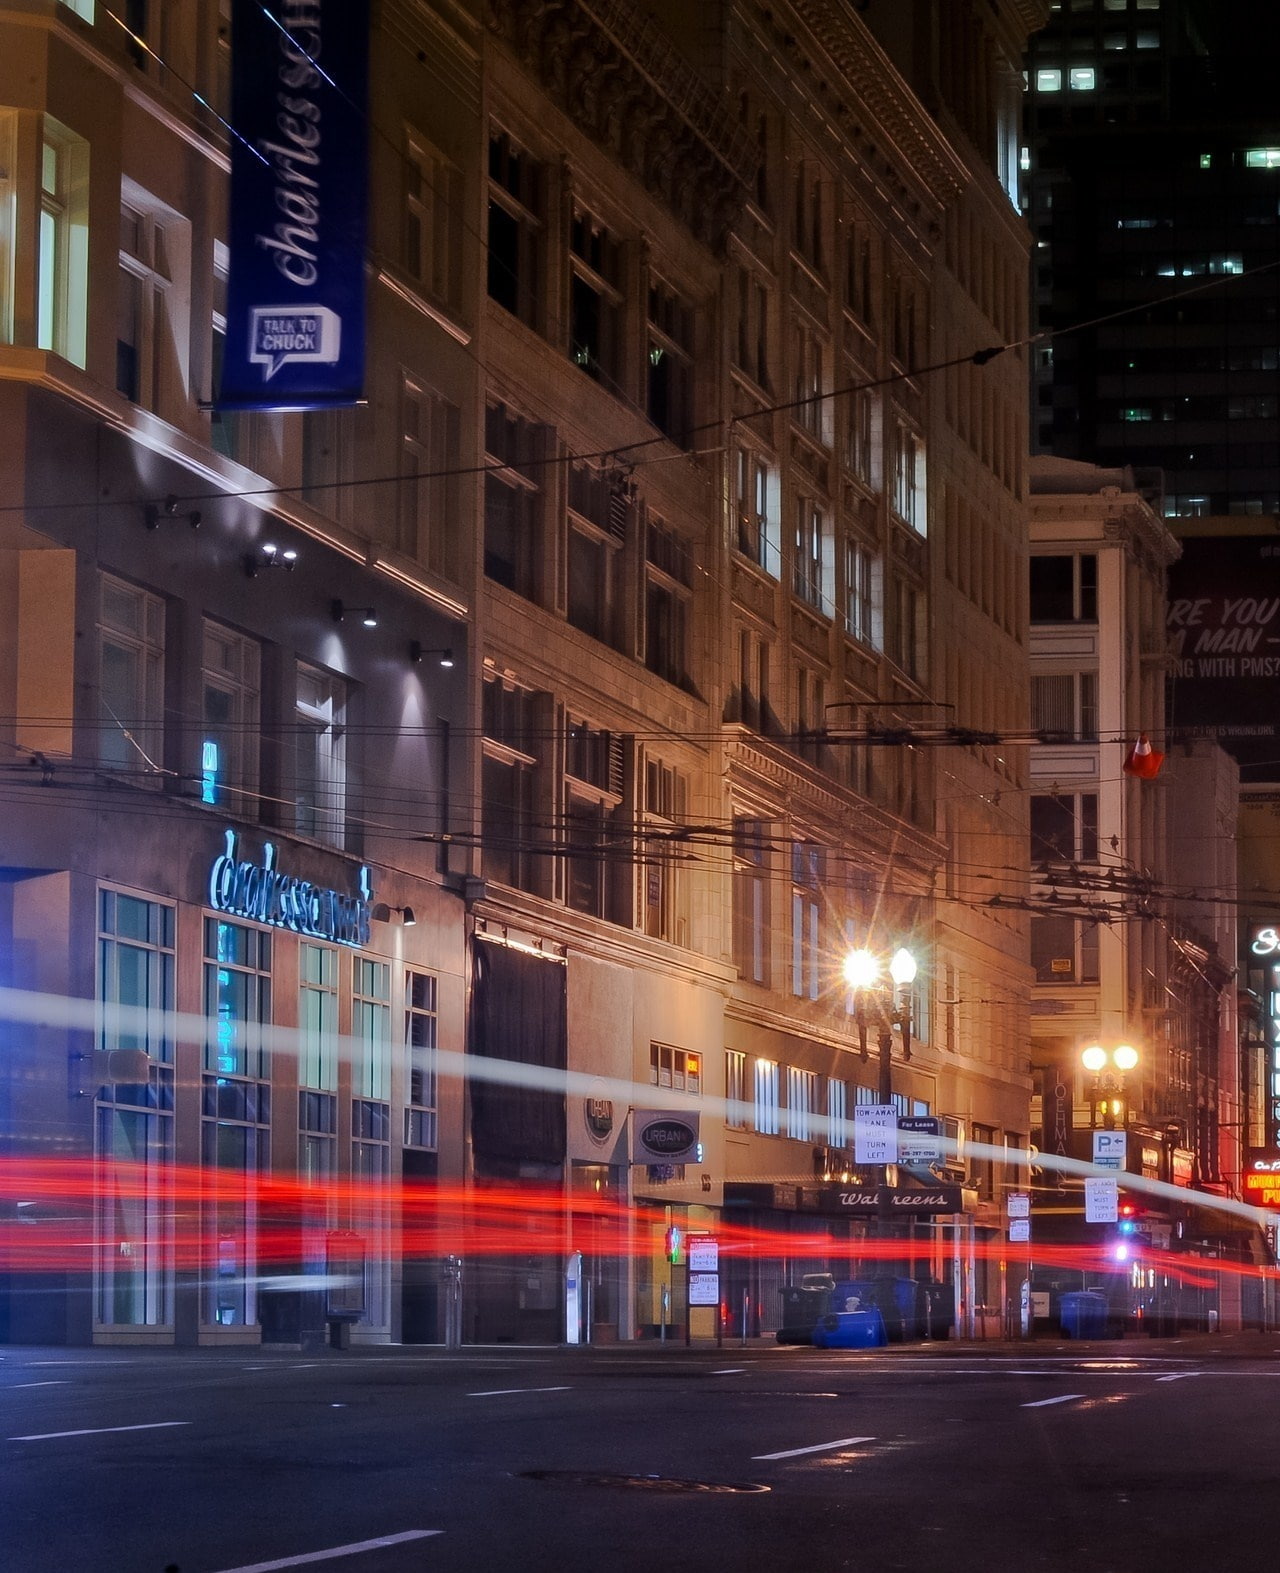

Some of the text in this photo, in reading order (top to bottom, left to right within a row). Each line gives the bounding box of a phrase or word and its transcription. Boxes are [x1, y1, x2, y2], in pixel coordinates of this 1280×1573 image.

[264, 319, 317, 334] TALK TO
[263, 334, 315, 350] CHUCK
[1165, 597, 1280, 626] RE YOU
[1194, 627, 1263, 654] MAN
[1200, 658, 1236, 677] WITH
[1241, 656, 1280, 677] PMS?
[856, 1109, 896, 1117] TOW-AWAY
[839, 1192, 948, 1206] Walreens
